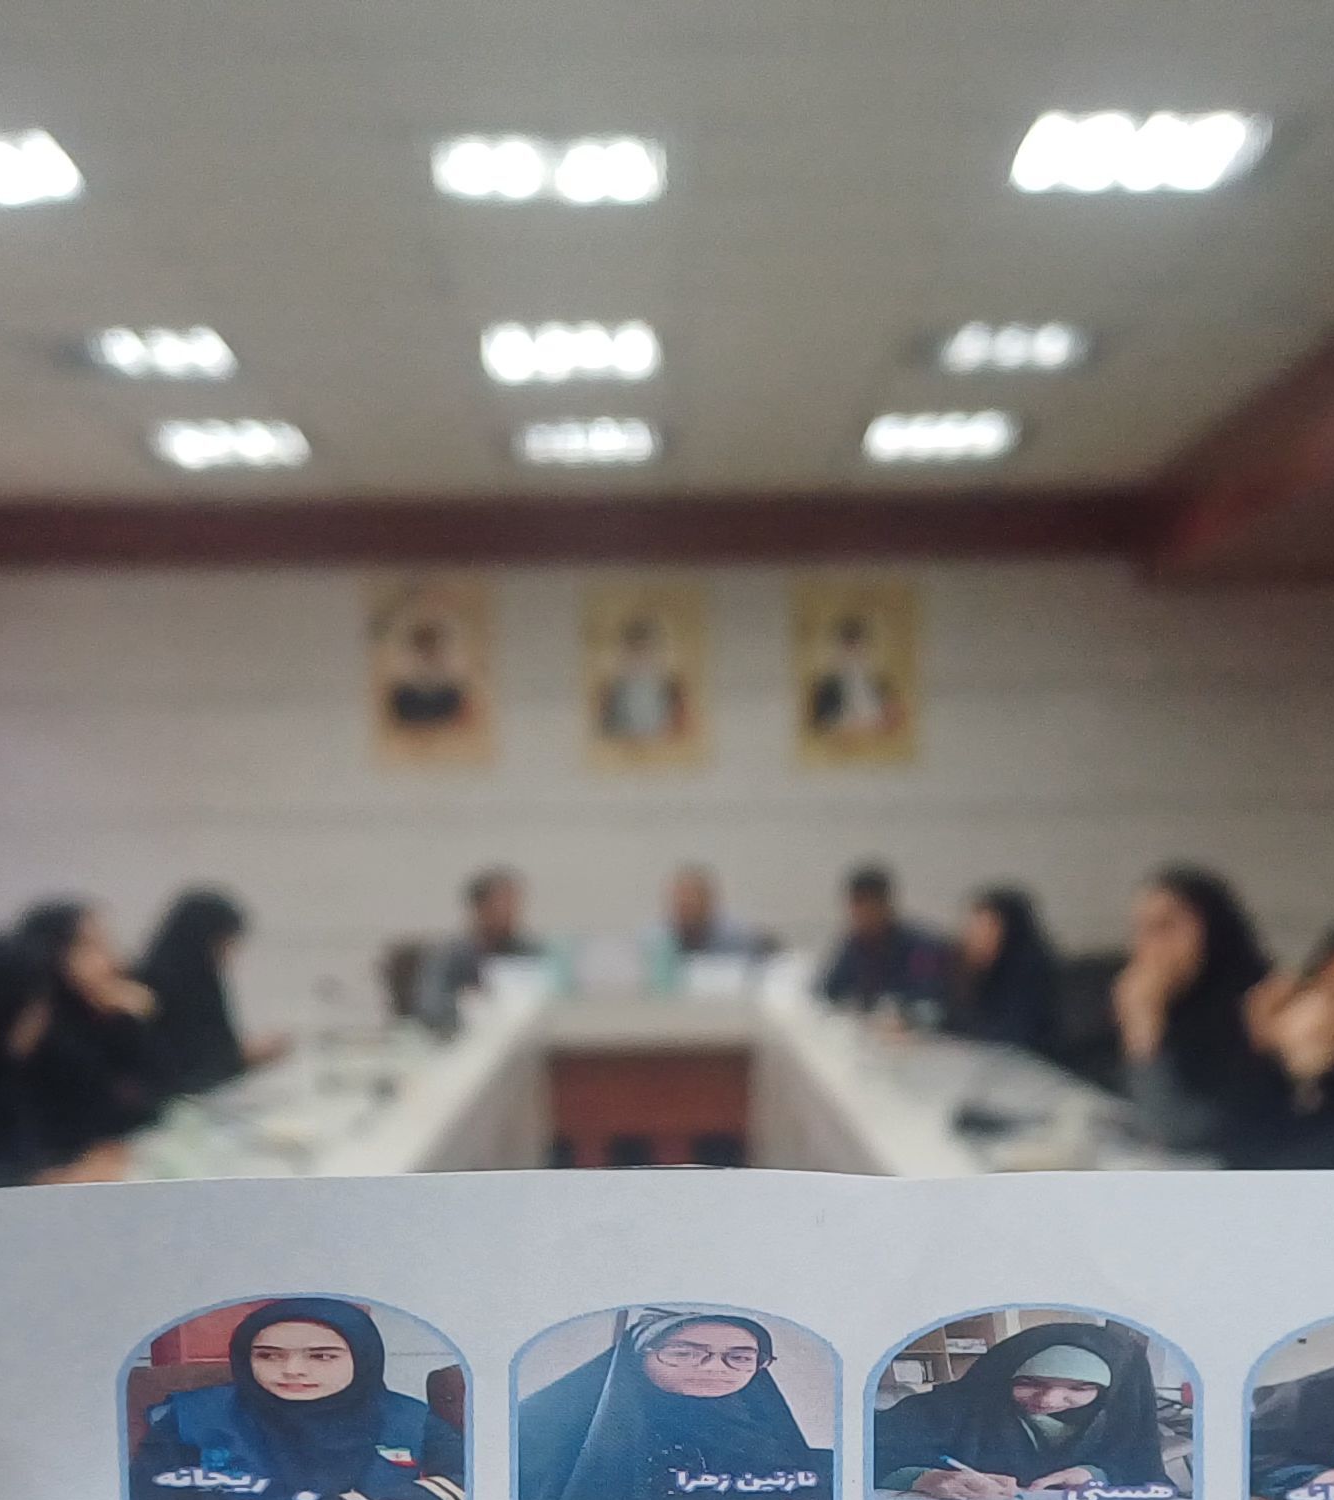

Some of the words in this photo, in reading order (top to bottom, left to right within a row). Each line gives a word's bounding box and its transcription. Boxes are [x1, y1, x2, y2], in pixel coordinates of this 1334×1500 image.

[151, 1466, 271, 1494] ریحانه
[675, 1469, 734, 1494] زهرا
[736, 1471, 819, 1493] نازنین
